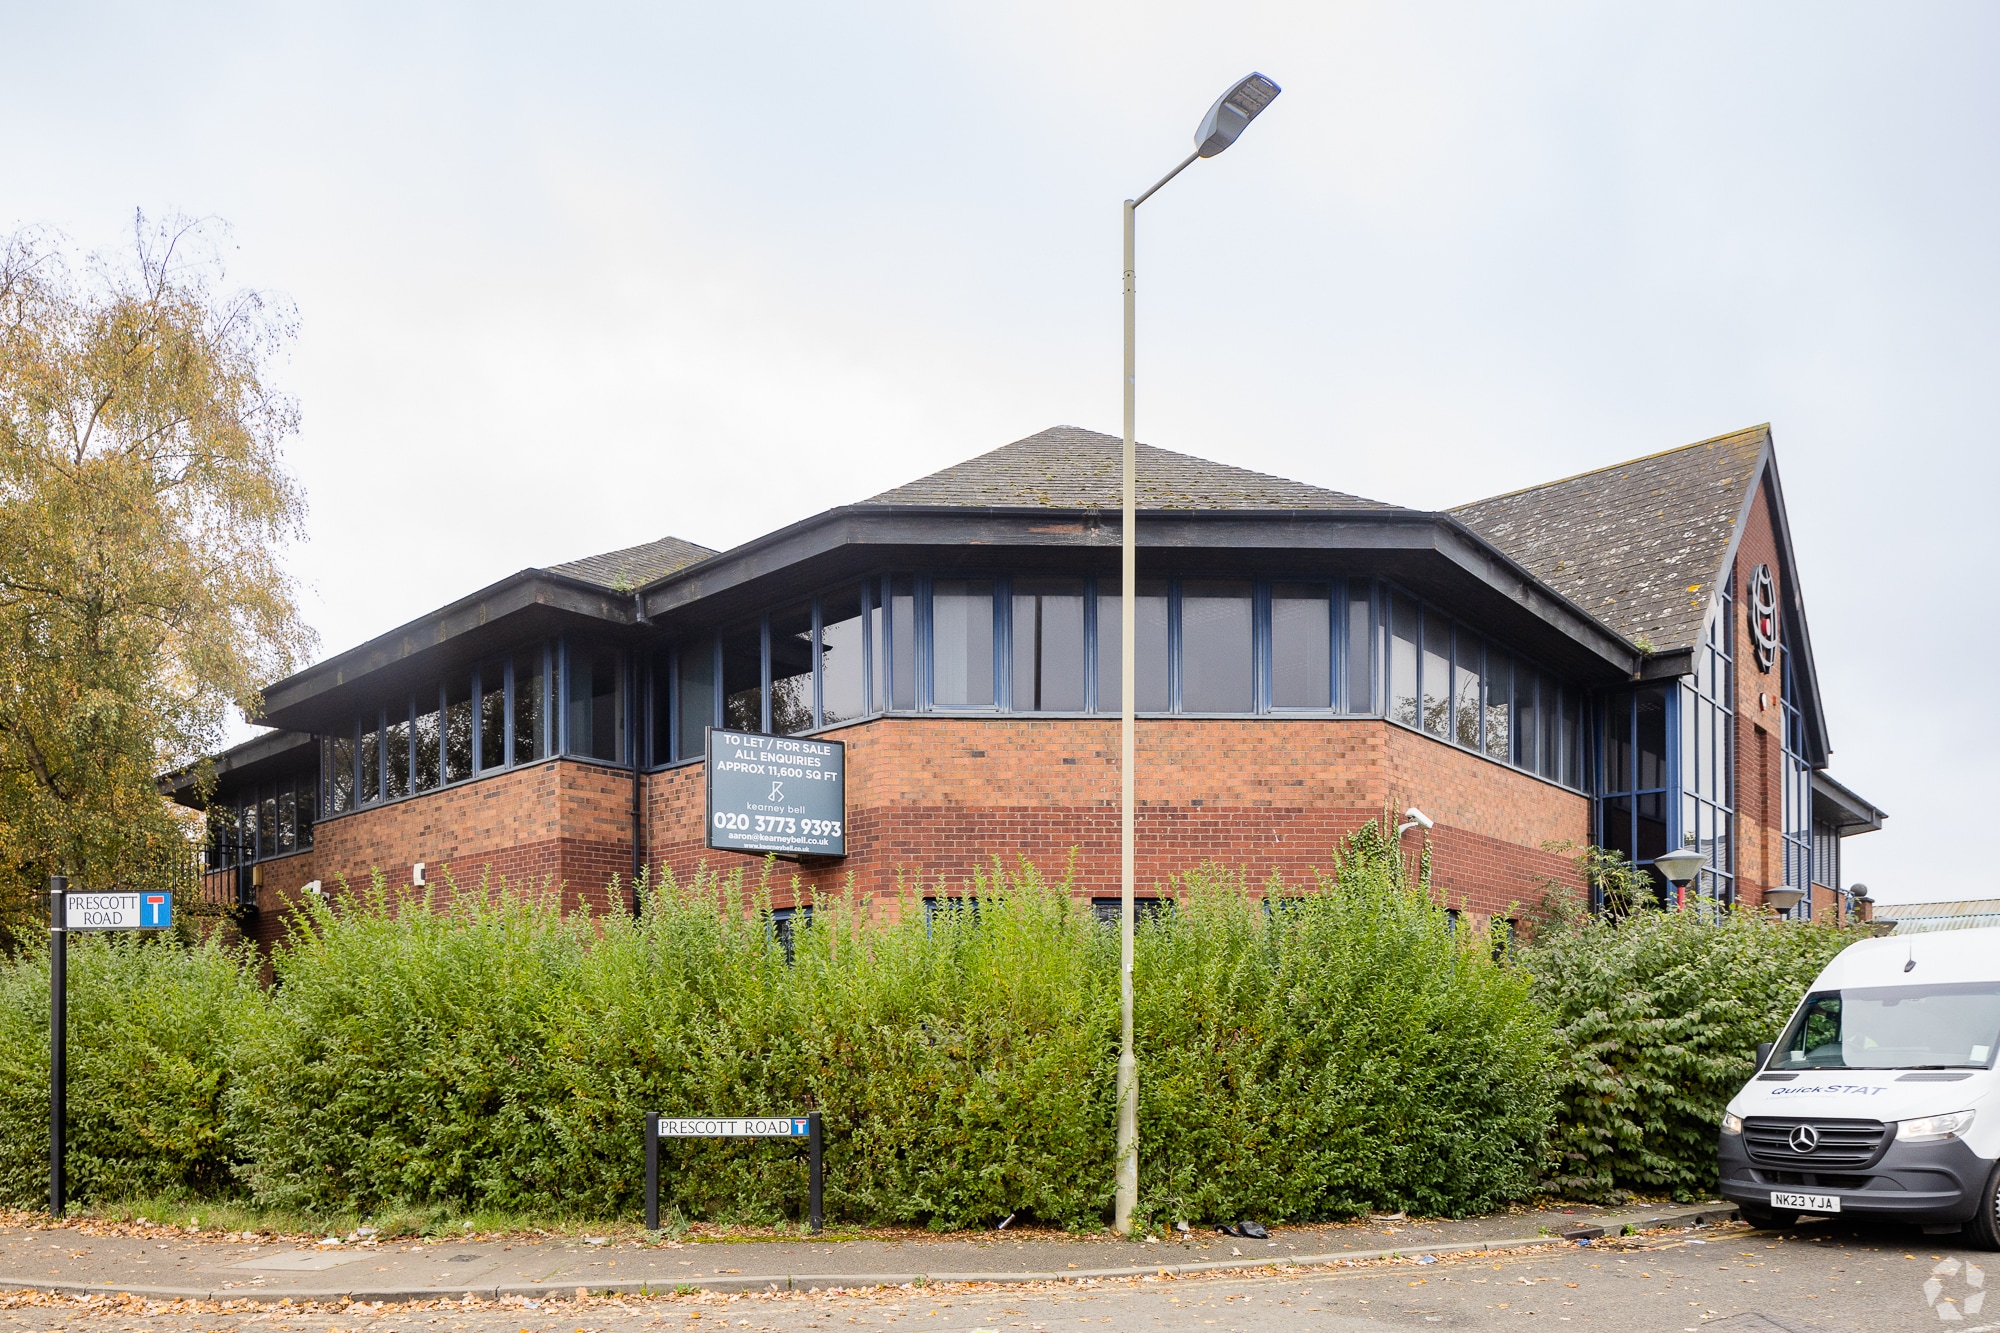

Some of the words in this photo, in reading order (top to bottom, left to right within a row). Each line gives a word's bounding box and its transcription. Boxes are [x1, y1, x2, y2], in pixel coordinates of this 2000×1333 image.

[724, 734, 740, 746] TO
[743, 737, 765, 748] LET
[767, 738, 774, 750] /
[776, 740, 800, 752] FOR
[802, 743, 831, 756] SALE
[735, 749, 757, 761] ALL
[760, 751, 821, 767] ENQUIRIES
[717, 760, 765, 775] APPROX
[768, 766, 803, 778] 11,600
[805, 771, 821, 780] SQ
[824, 771, 838, 782] FT
[746, 802, 784, 814] kearney
[787, 804, 805, 814] bell
[713, 812, 750, 830] 020
[754, 815, 796, 834] 3773
[801, 819, 842, 838] 9393
[728, 832, 829, 846] aaron@kearneybell.co.uk
[68, 896, 138, 910] PRESCOTT
[83, 911, 123, 925] ROAD
[1771, 1085, 1888, 1096] QuickSTAT
[661, 1120, 738, 1134] PRESCOTT
[745, 1120, 790, 1134] ROAD
[1775, 1194, 1805, 1207] NK23
[1809, 1196, 1833, 1209] YJA
